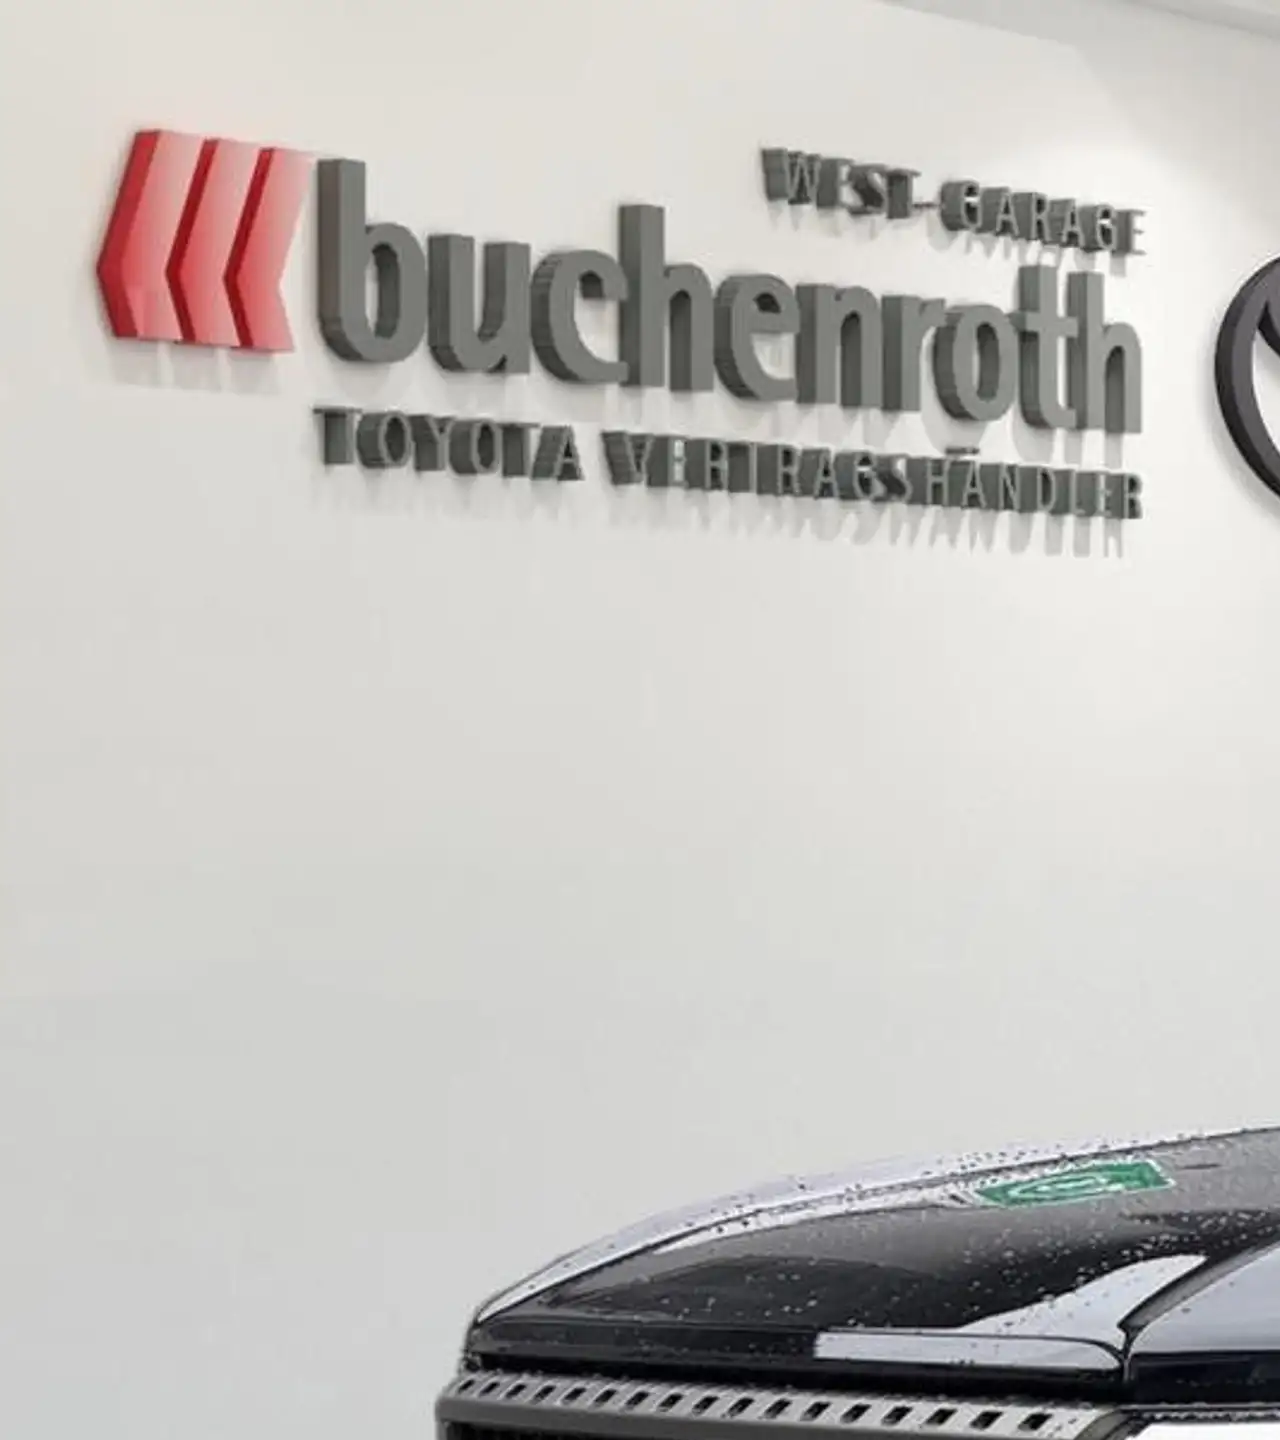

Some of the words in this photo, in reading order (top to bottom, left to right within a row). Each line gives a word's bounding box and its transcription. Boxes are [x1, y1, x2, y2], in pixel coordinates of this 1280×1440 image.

[761, 147, 1147, 255] WEST-GARAGE
[316, 158, 1143, 435] buchenroth
[312, 408, 586, 481] TOYOTA
[600, 430, 1143, 520] VERTRAGSHÄNDLER
